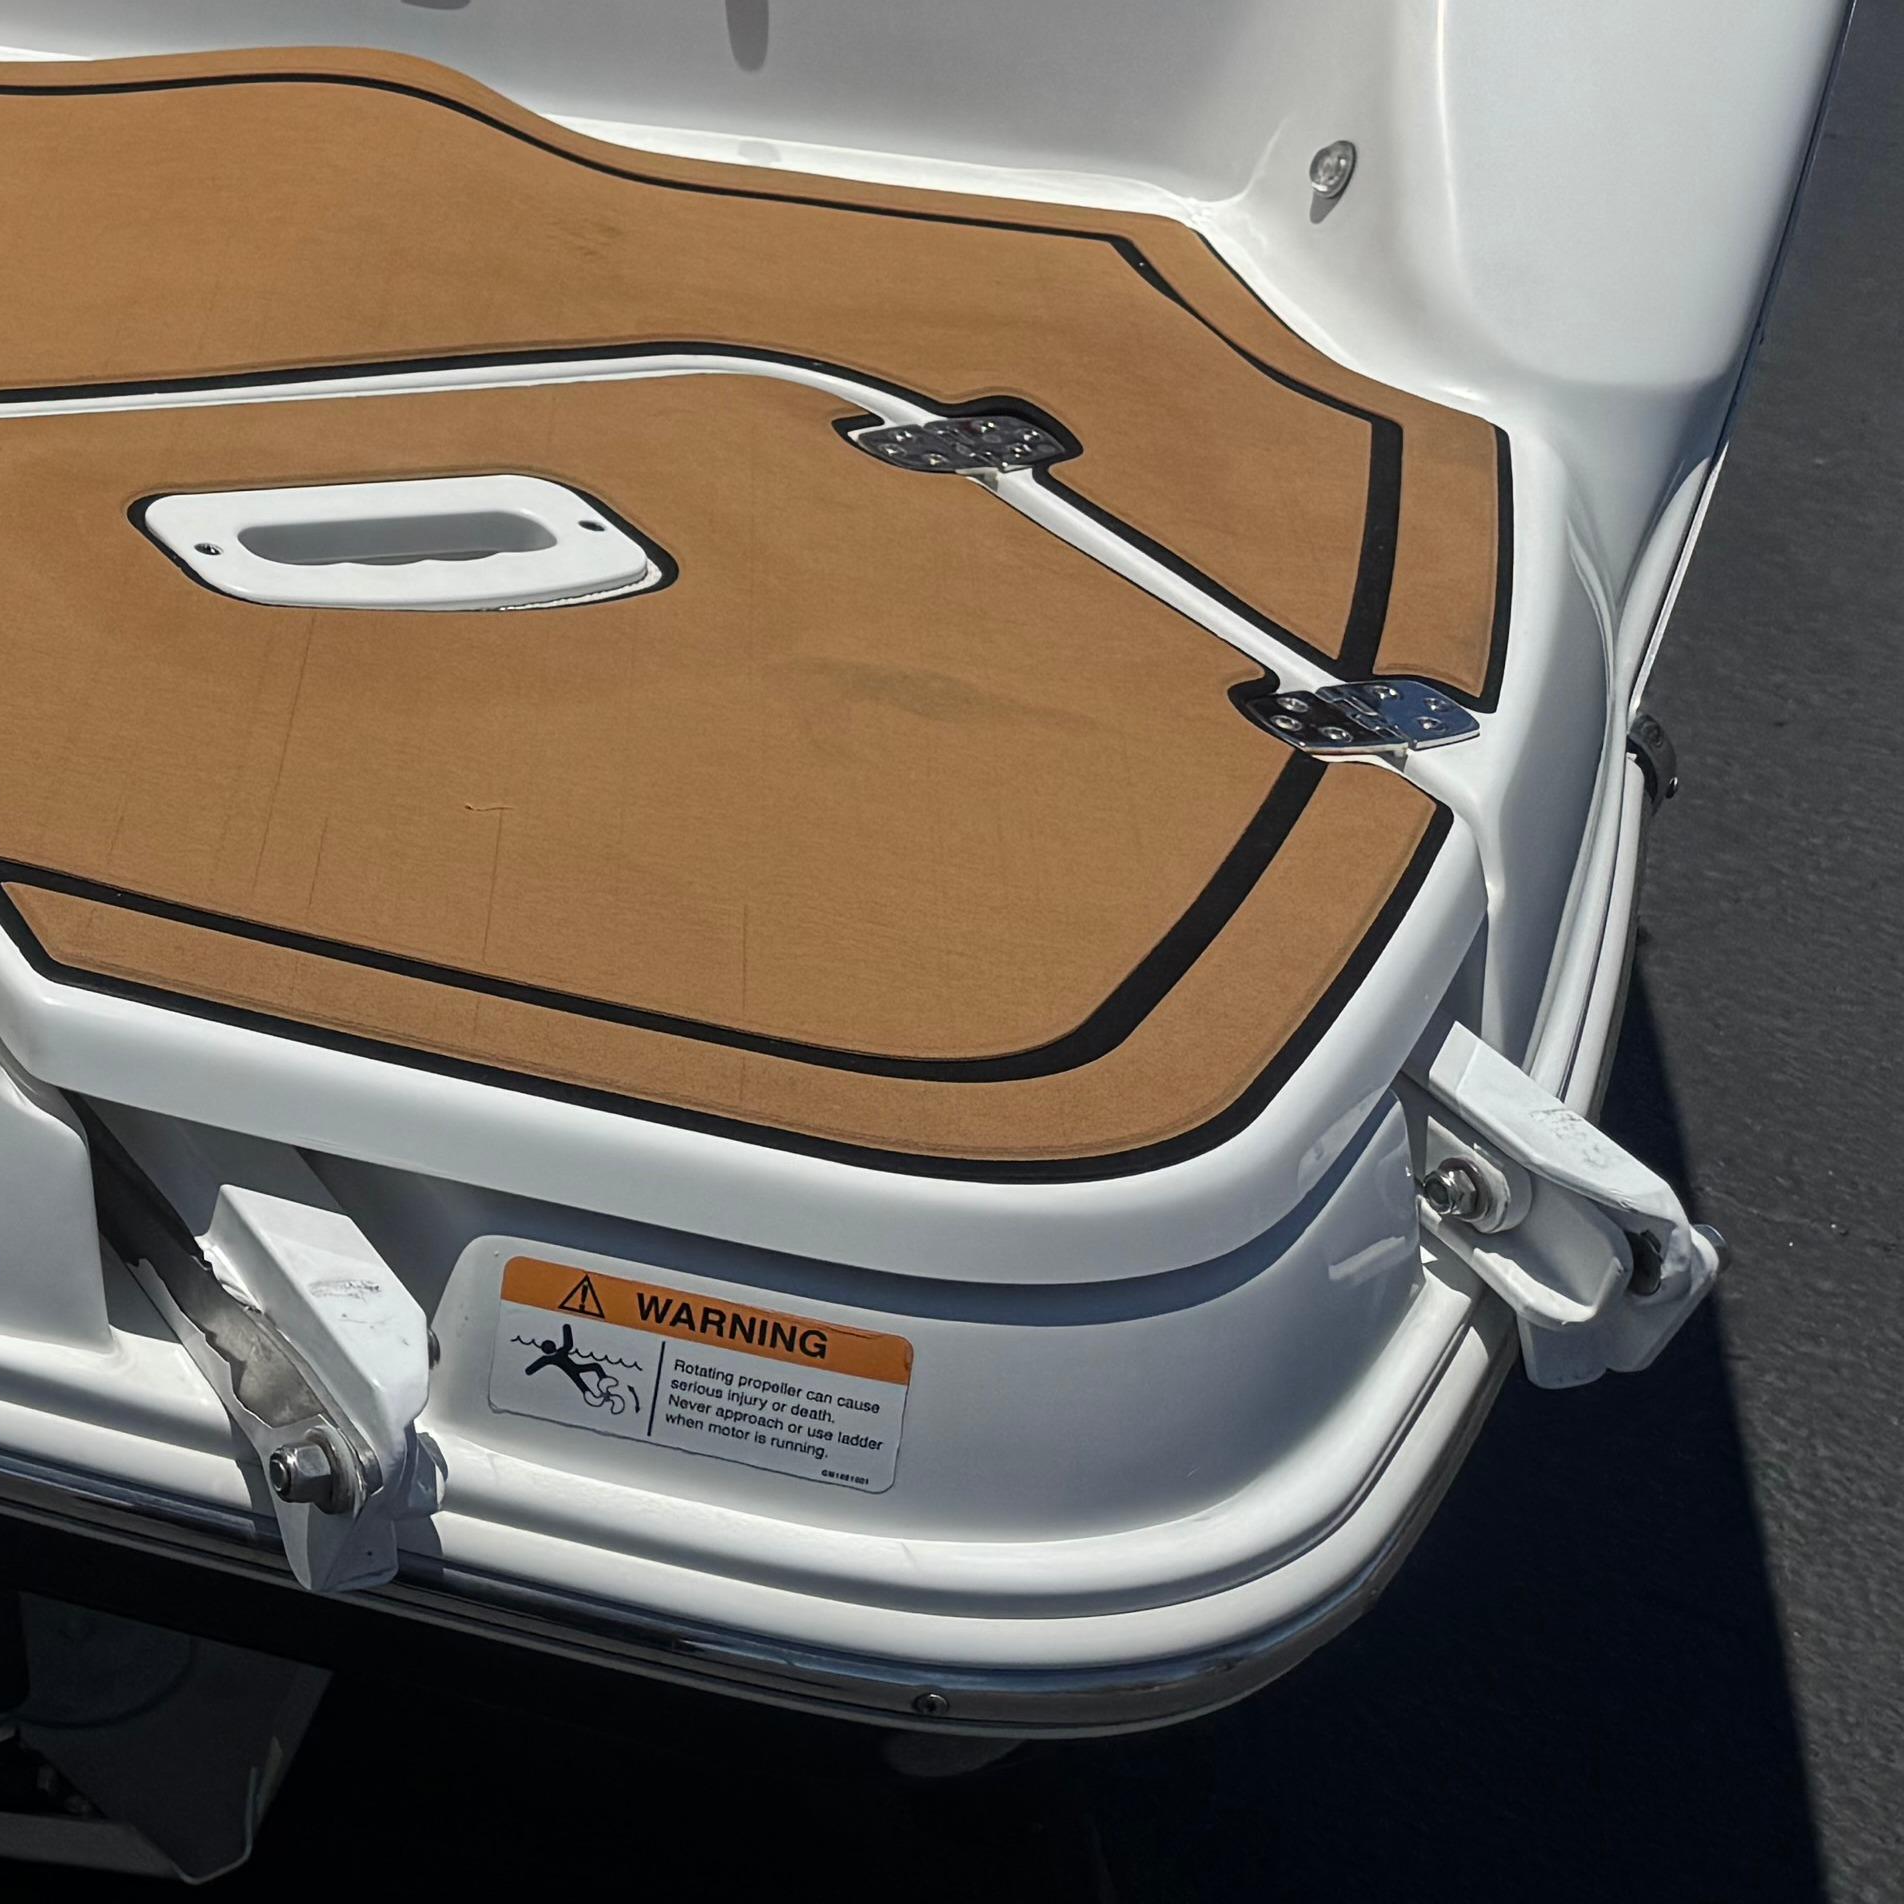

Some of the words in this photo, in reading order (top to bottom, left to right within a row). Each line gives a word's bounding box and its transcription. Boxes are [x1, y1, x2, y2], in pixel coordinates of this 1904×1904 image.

[635, 1292, 829, 1360] WARNING
[670, 1377, 723, 1399] serious
[727, 1389, 768, 1411] injury
[771, 1400, 787, 1413] or
[790, 1401, 835, 1424] death.
[673, 1358, 734, 1386] Rotating
[738, 1375, 803, 1399] propeller
[805, 1389, 833, 1405] can
[837, 1394, 881, 1414] cause
[665, 1412, 704, 1431] when
[707, 1421, 751, 1440] motor
[754, 1431, 767, 1445] is
[770, 1435, 828, 1461] running.
[668, 1393, 712, 1415] Never
[715, 1405, 784, 1431] approach
[787, 1422, 803, 1435] or
[807, 1427, 834, 1442] use
[837, 1431, 884, 1451] ladder
